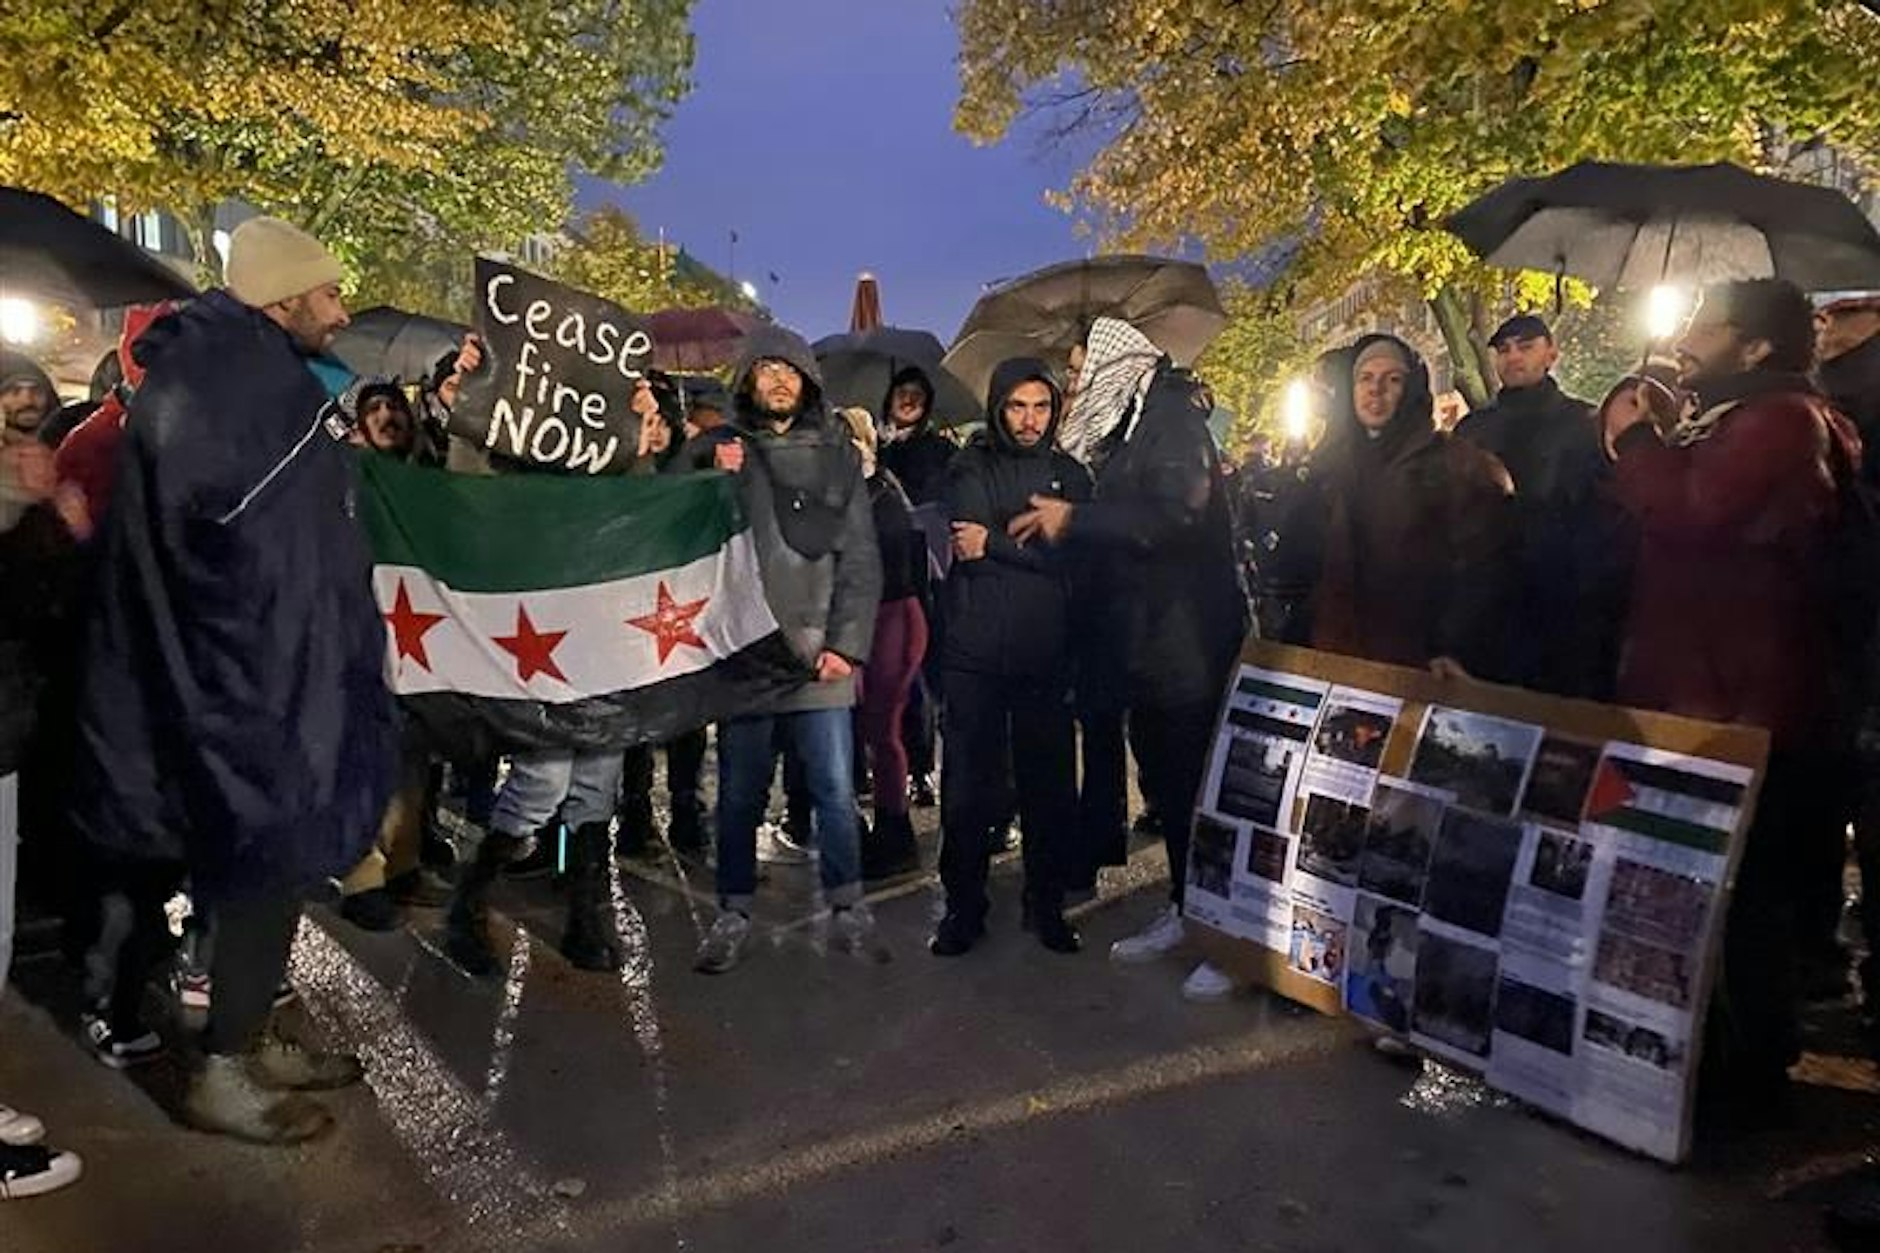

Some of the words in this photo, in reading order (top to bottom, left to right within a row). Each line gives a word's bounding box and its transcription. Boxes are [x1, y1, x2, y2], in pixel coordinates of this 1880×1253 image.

[487, 274, 651, 378] Cease
[515, 342, 606, 428] fire
[485, 398, 618, 474] NOW
